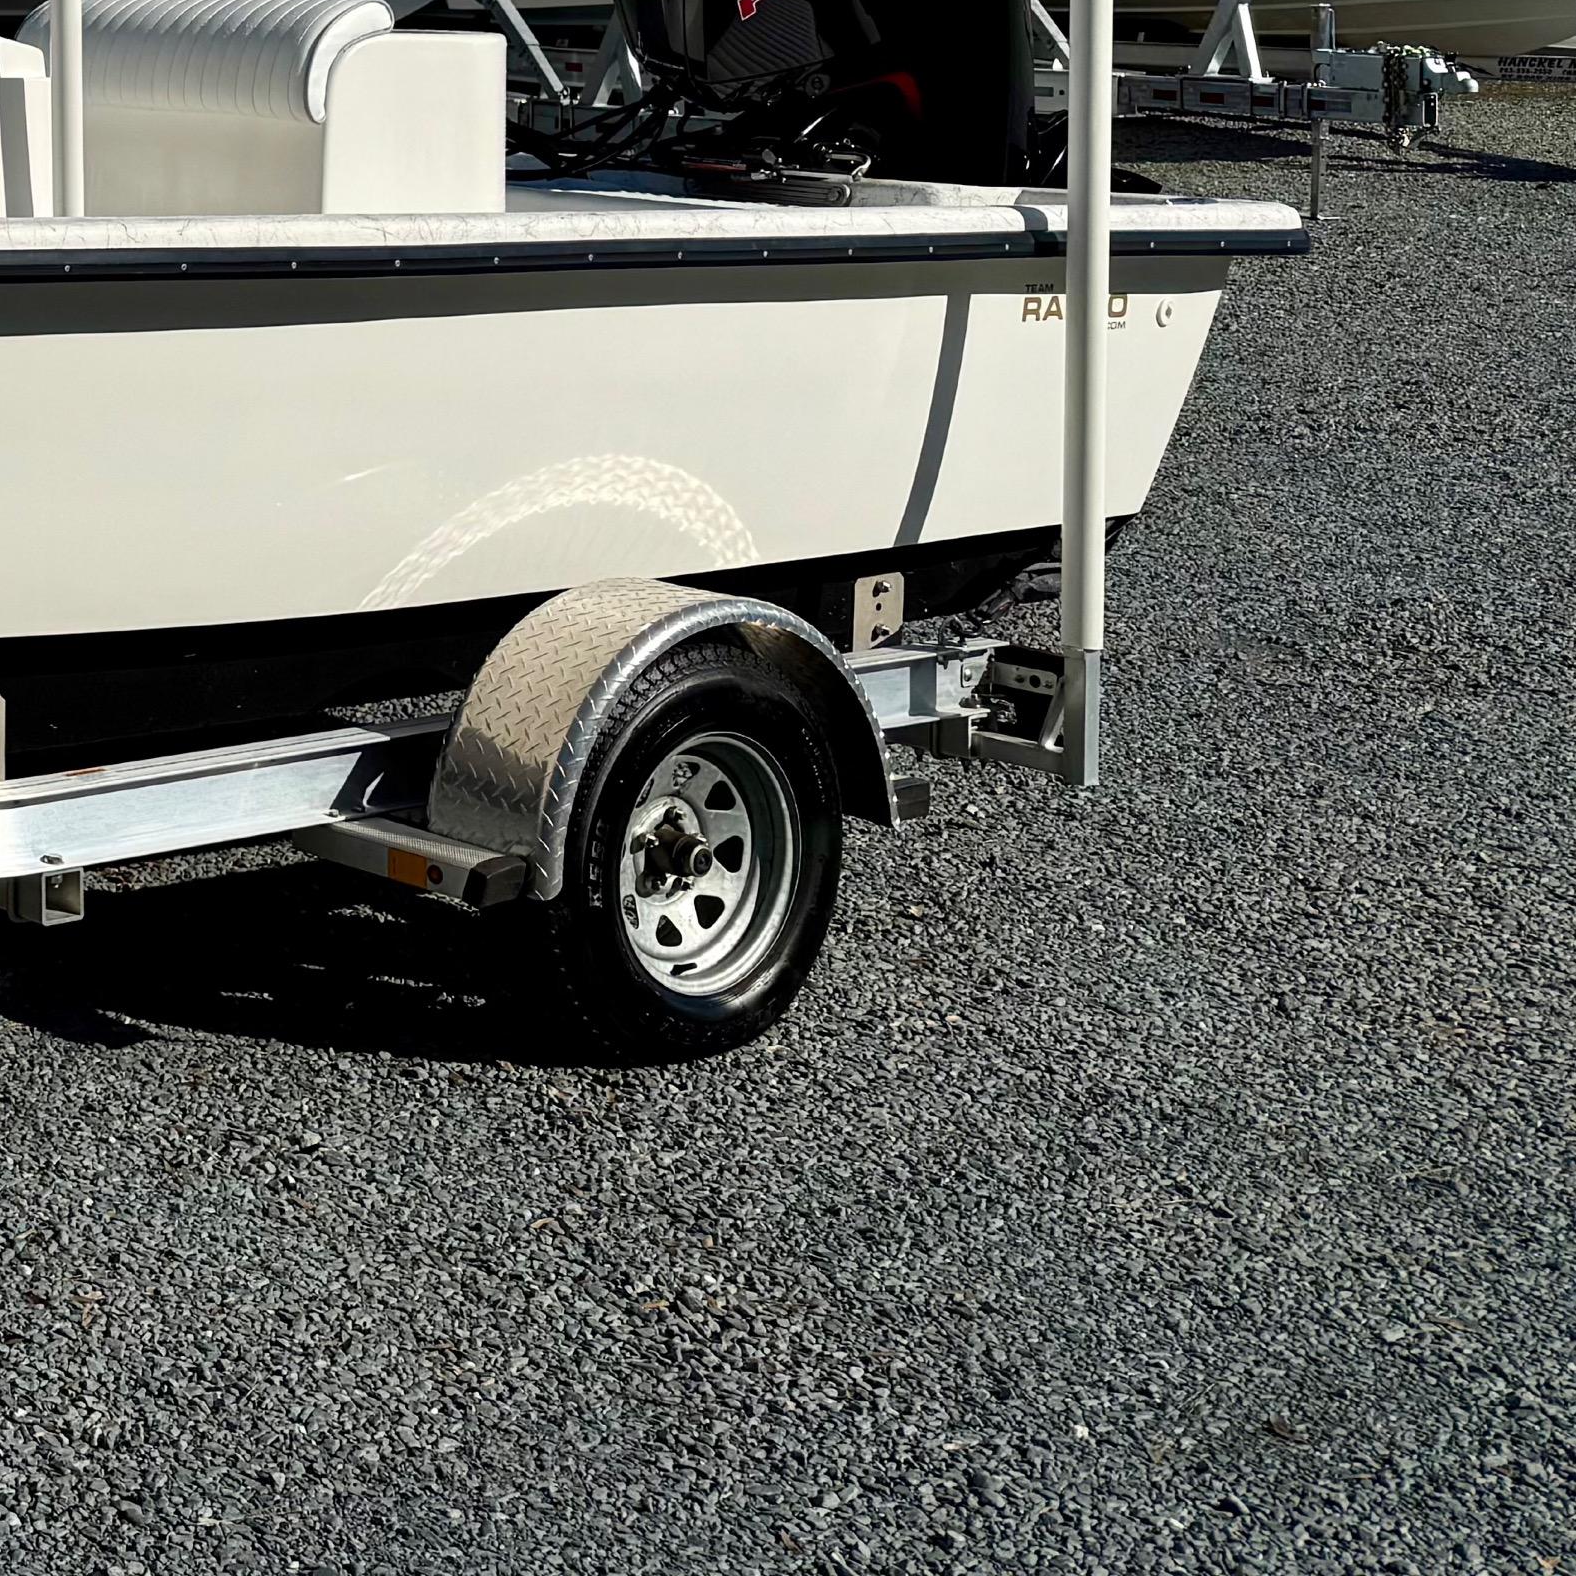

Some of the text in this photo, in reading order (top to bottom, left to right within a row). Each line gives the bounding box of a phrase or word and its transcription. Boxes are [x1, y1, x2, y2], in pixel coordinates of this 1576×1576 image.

[1497, 57, 1563, 68] HANCKEL
[1026, 284, 1054, 293] TEAM
[1022, 294, 1128, 322] RAO
